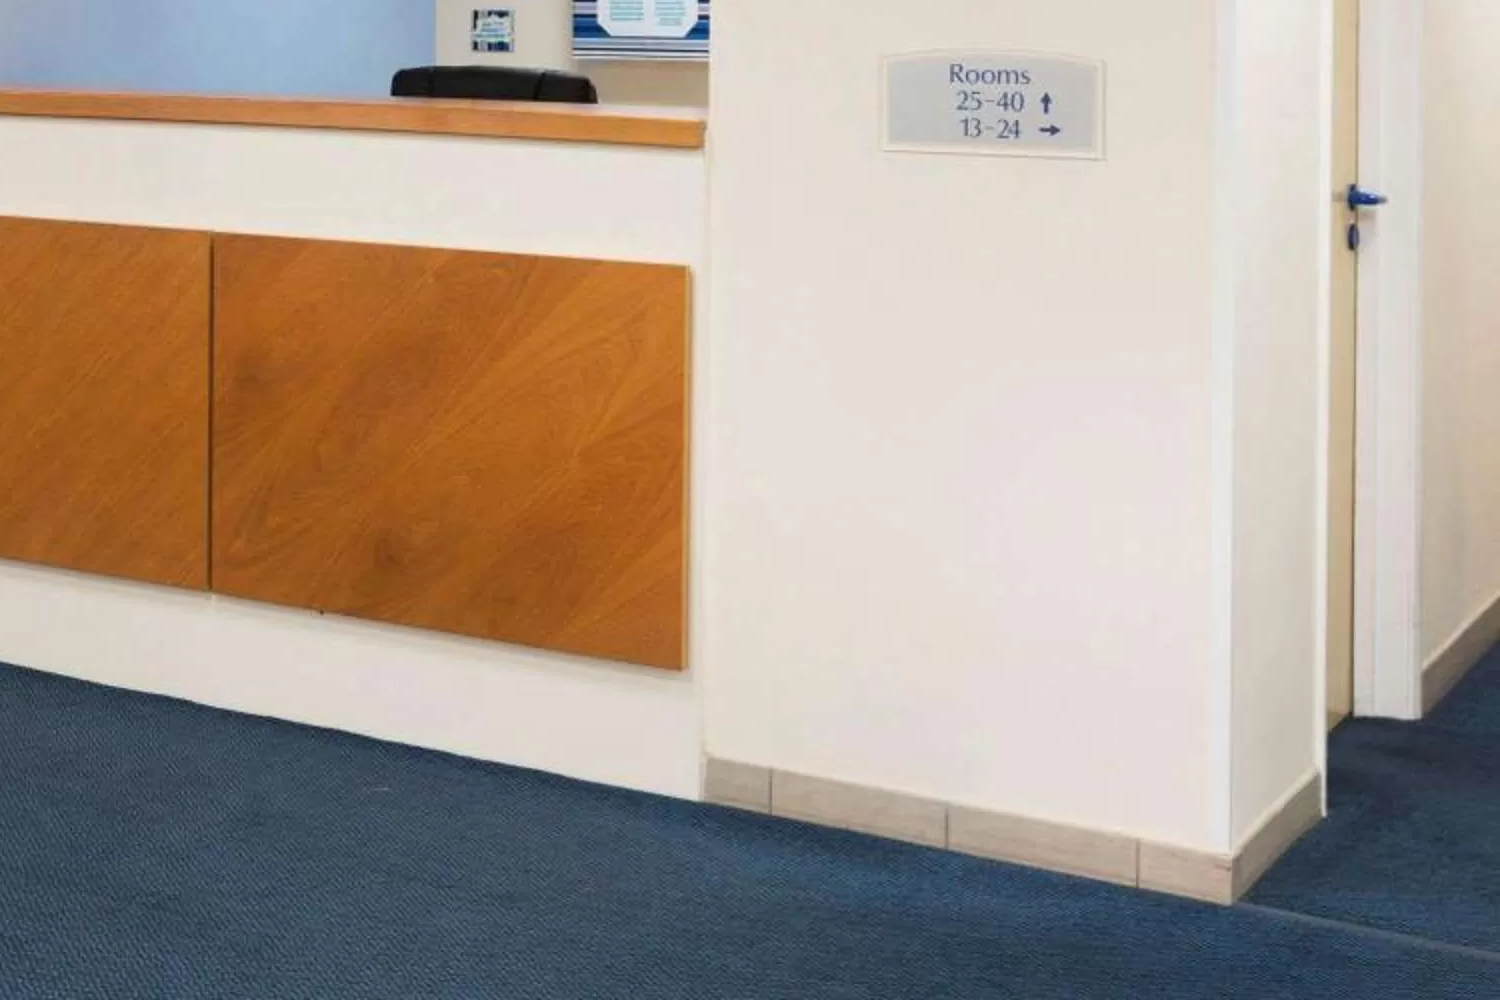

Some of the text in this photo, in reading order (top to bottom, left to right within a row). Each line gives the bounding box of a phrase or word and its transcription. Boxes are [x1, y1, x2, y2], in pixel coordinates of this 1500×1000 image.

[949, 63, 1032, 85] Rooms
[955, 89, 1025, 113] 25-40
[960, 116, 1020, 139] 13-24
